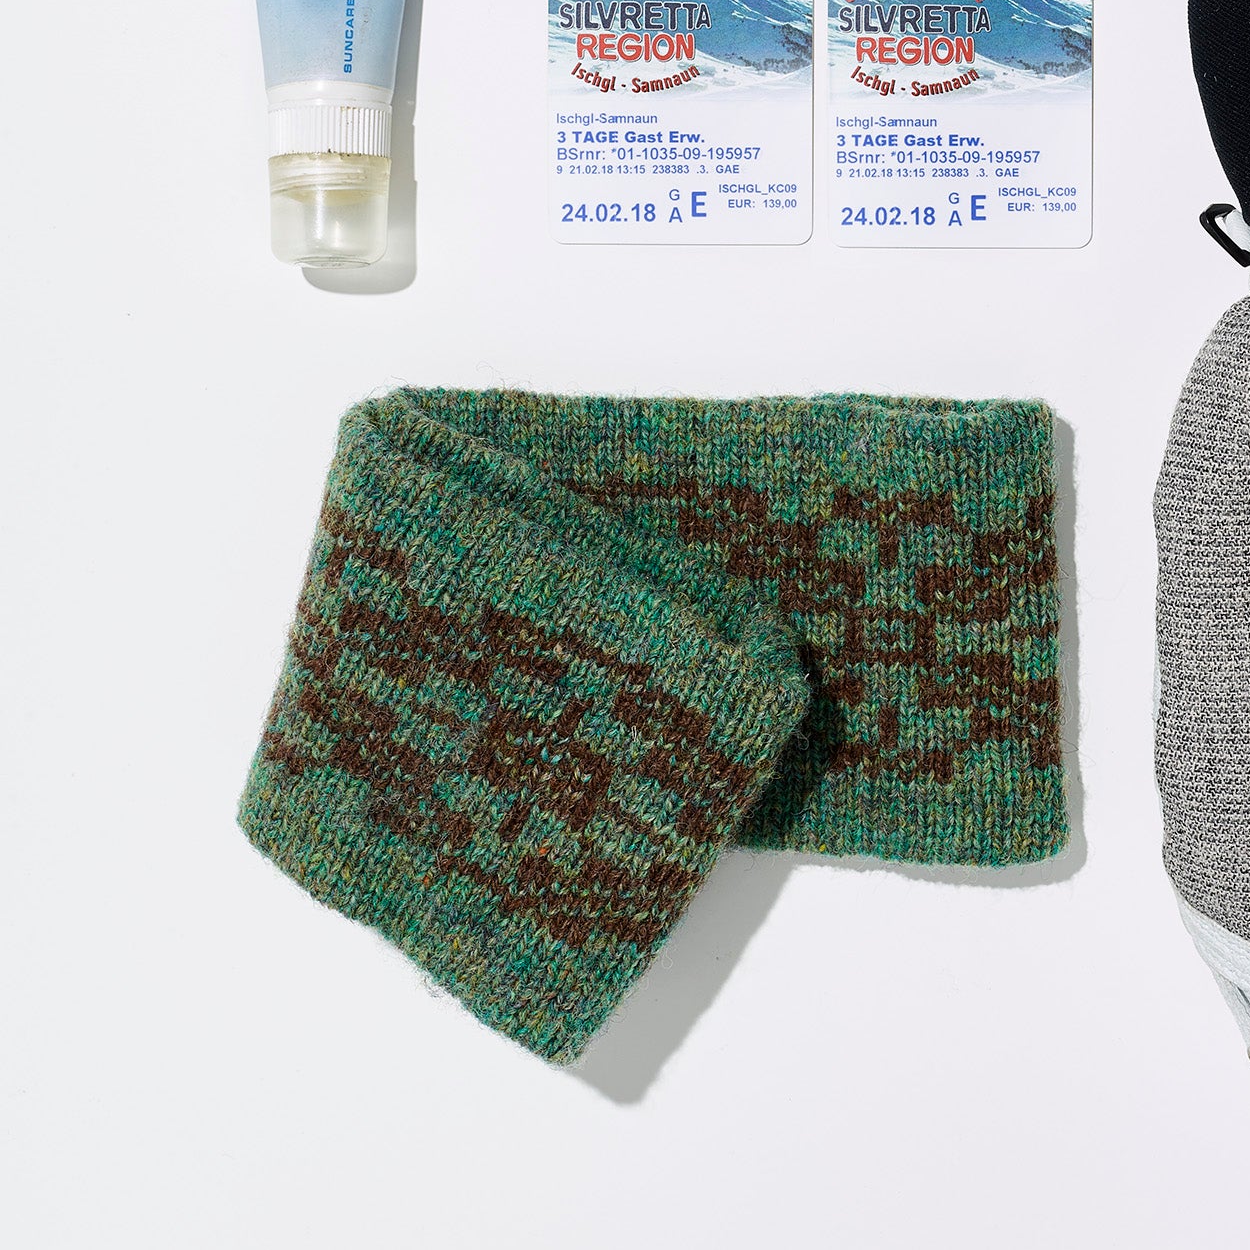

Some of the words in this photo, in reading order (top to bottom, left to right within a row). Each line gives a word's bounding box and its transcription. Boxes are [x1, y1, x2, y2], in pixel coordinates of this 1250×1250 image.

[559, 1, 712, 31] SILVRETTA
[838, 4, 992, 35] SILVRETTA
[576, 33, 696, 62] REGION
[855, 36, 976, 66] REGION
[571, 62, 616, 93] Ischgl
[631, 65, 701, 94] Samnaun
[850, 65, 896, 97] Ischgl
[910, 68, 981, 98] Samnaun
[556, 112, 658, 126] Ischgl-Samnaun
[835, 115, 938, 130] Ischgl-Samnaun
[557, 131, 566, 143] 3
[572, 131, 619, 143] TAGE
[624, 131, 663, 143] Gast
[669, 131, 705, 143] Erw.
[836, 134, 846, 147] 3
[851, 134, 899, 147] TAGE
[903, 134, 943, 147] Gast
[948, 134, 985, 147] Erw.
[557, 147, 606, 161] BSrnr:
[836, 150, 886, 165] BSrnr:
[556, 165, 563, 175] 9
[569, 165, 614, 175] 21.02.18
[617, 165, 646, 175] 13:15
[652, 165, 690, 175] 238383
[715, 165, 740, 175] GAE
[835, 168, 843, 179] 9
[848, 168, 894, 179] 21.02.18
[896, 168, 926, 179] 13:15
[931, 168, 970, 179] 238383
[994, 168, 1020, 179] GAE
[668, 188, 680, 201] G
[719, 184, 797, 195] ISCHGL_KC09
[998, 187, 1077, 199] ISCHGL_KC09
[691, 191, 707, 217] E
[728, 199, 756, 208] EUR:
[763, 199, 797, 209] 139,00
[947, 191, 960, 205] G
[561, 203, 656, 223] 24.02.18
[668, 207, 683, 223] A
[970, 194, 987, 221] E
[1007, 202, 1036, 212] EUR:
[1042, 202, 1077, 213] 139,00
[840, 206, 936, 227] 24.02.18
[947, 210, 963, 227] A
